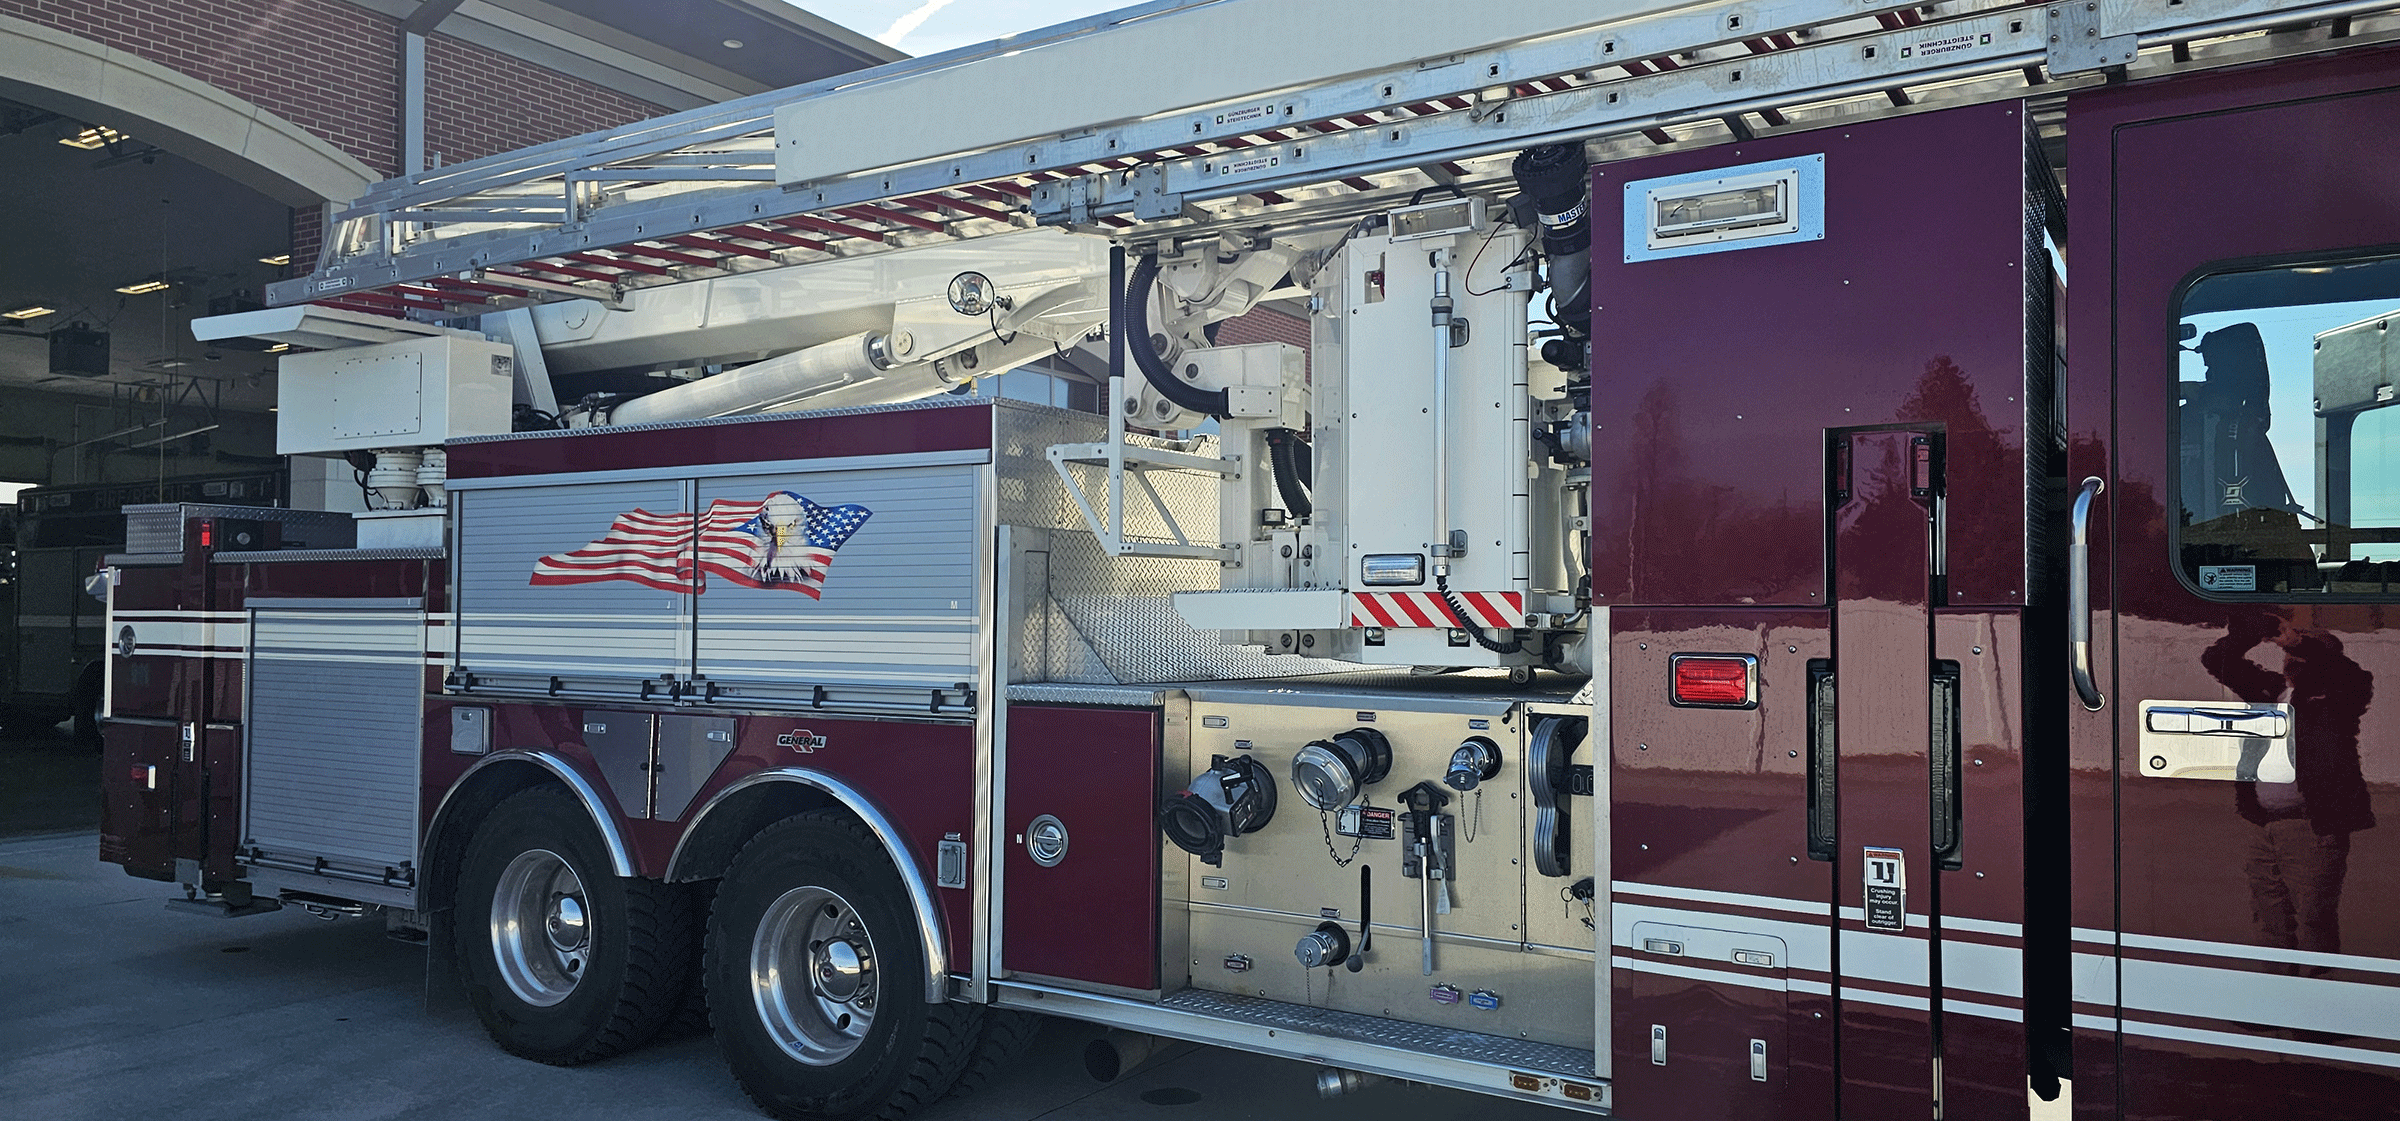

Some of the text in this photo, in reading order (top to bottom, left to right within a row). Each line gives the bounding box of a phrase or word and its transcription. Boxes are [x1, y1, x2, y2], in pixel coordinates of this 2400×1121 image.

[1919, 35, 1974, 49] STEIGTECHNIK
[1227, 113, 1261, 123] STEIGTECHNIK
[950, 600, 957, 609] M
[779, 735, 823, 746] GENERAL
[1016, 834, 1022, 843] N
[1870, 887, 1895, 895] Crushing
